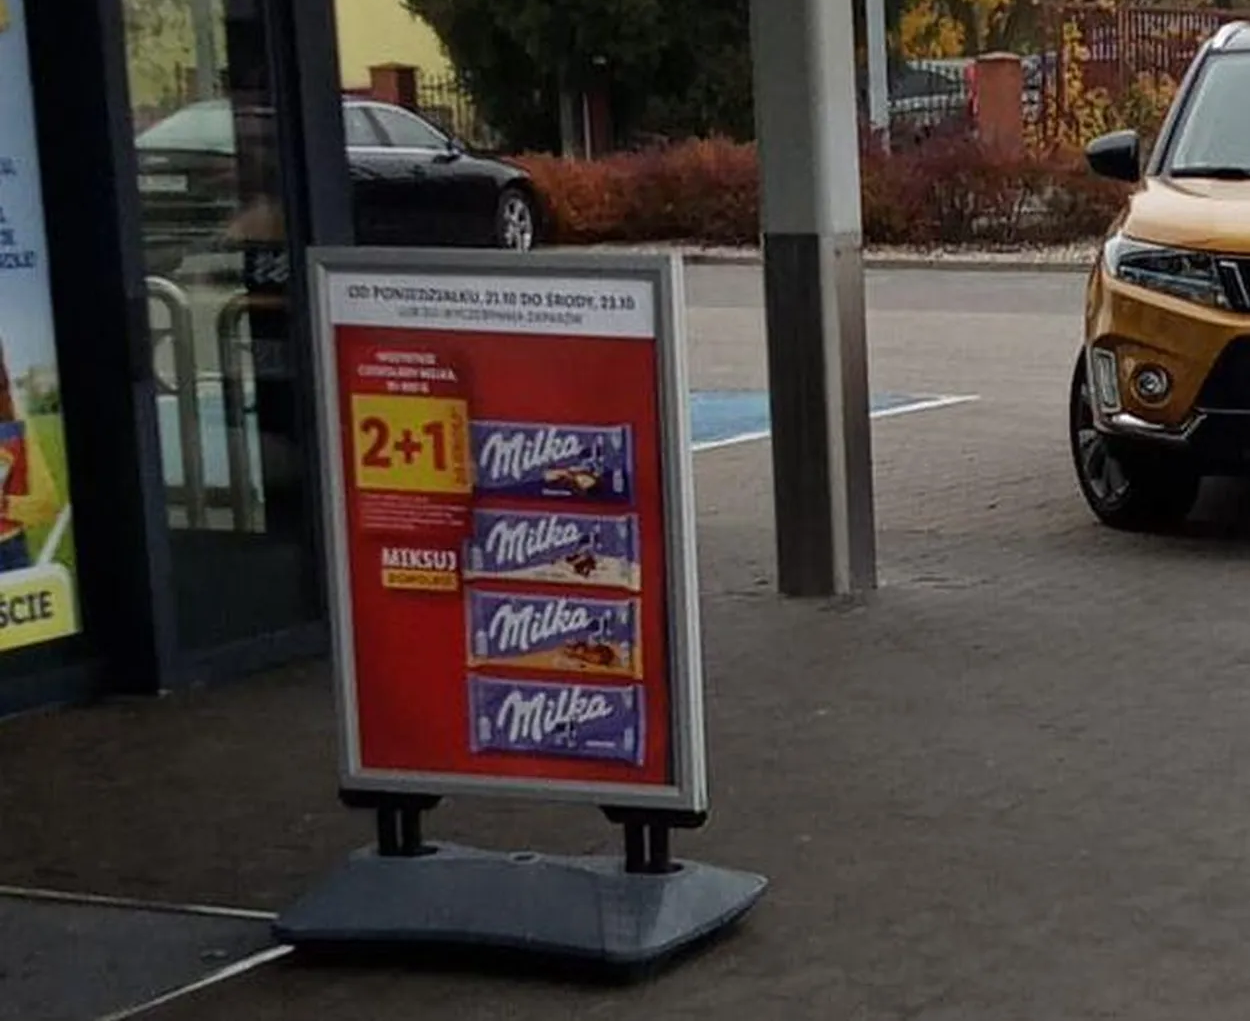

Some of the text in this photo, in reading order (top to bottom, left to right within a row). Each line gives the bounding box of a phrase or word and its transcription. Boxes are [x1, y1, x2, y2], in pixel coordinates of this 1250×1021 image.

[348, 285, 370, 299] OD
[520, 292, 543, 307] DO
[361, 416, 447, 473] 2+1
[480, 427, 584, 481] Milka
[381, 546, 457, 572] MIKSUJ
[485, 514, 585, 564] Milka
[488, 597, 595, 652] Milka
[496, 686, 613, 743] Milka
